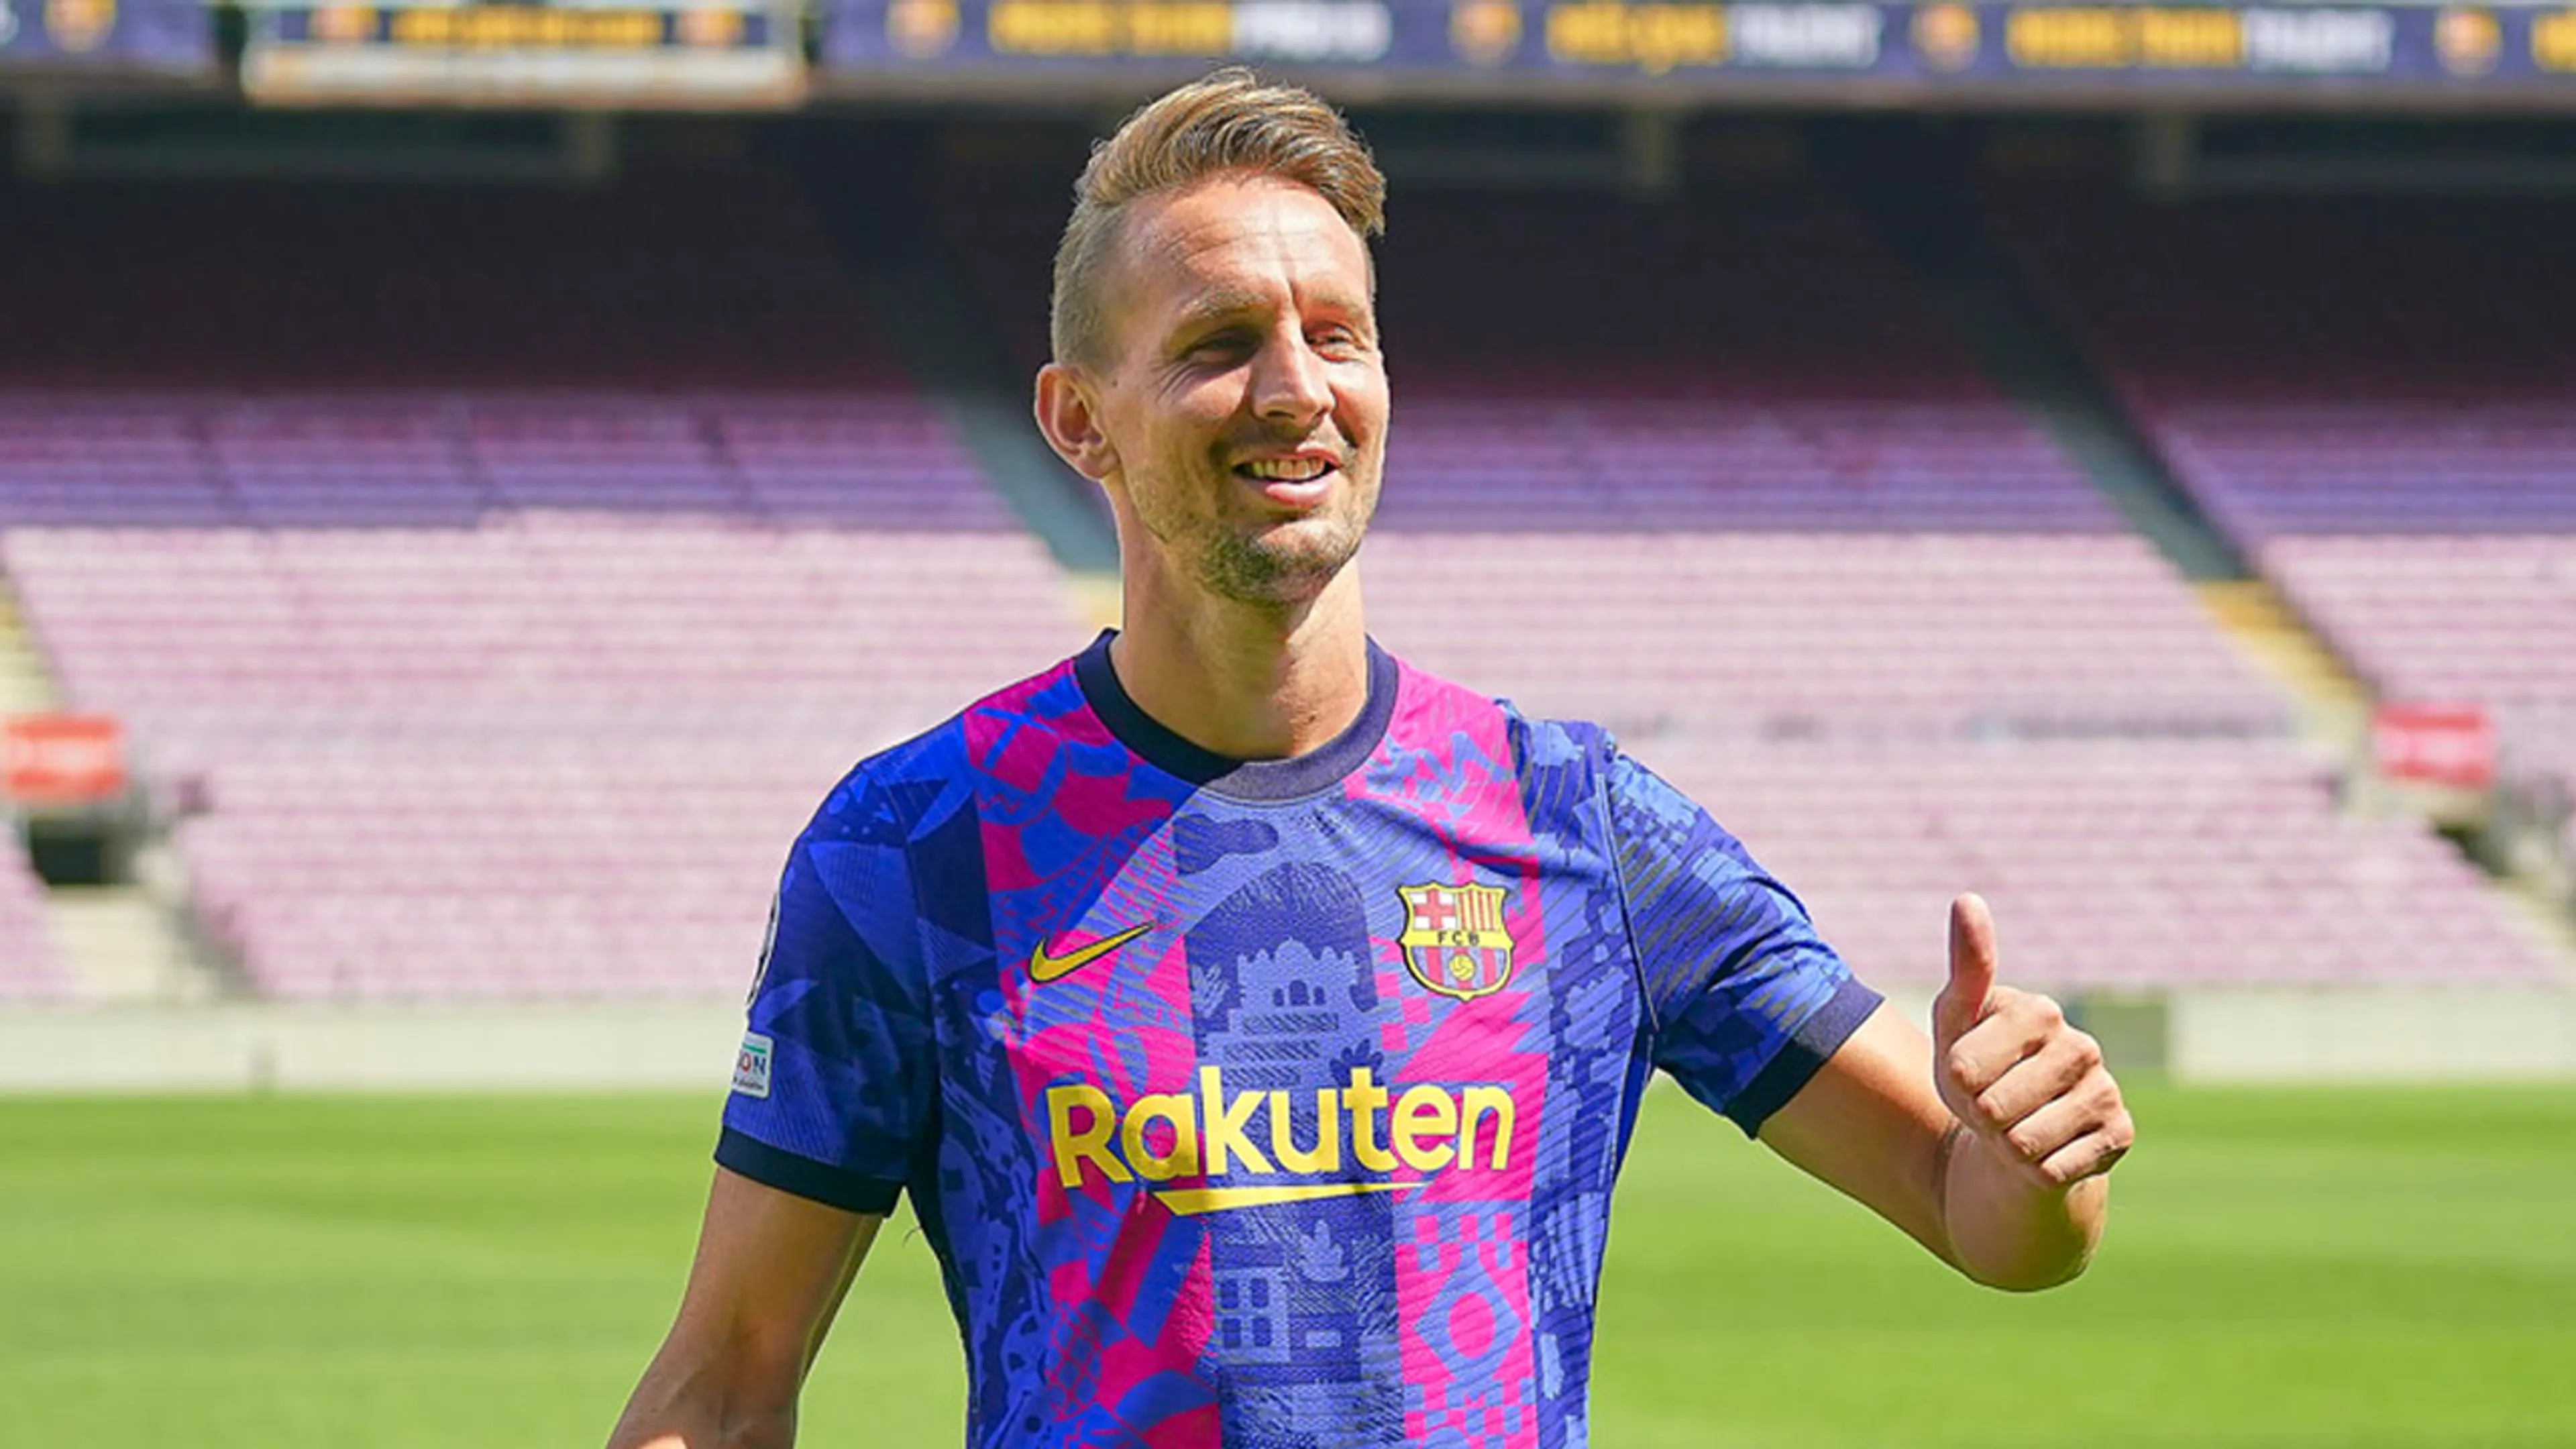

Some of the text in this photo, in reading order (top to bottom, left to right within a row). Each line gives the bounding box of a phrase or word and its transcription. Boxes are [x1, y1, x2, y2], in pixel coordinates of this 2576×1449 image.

[1437, 930, 1480, 947] FCB
[737, 1051, 767, 1076] ON
[1046, 1066, 1514, 1187] Rakuten
